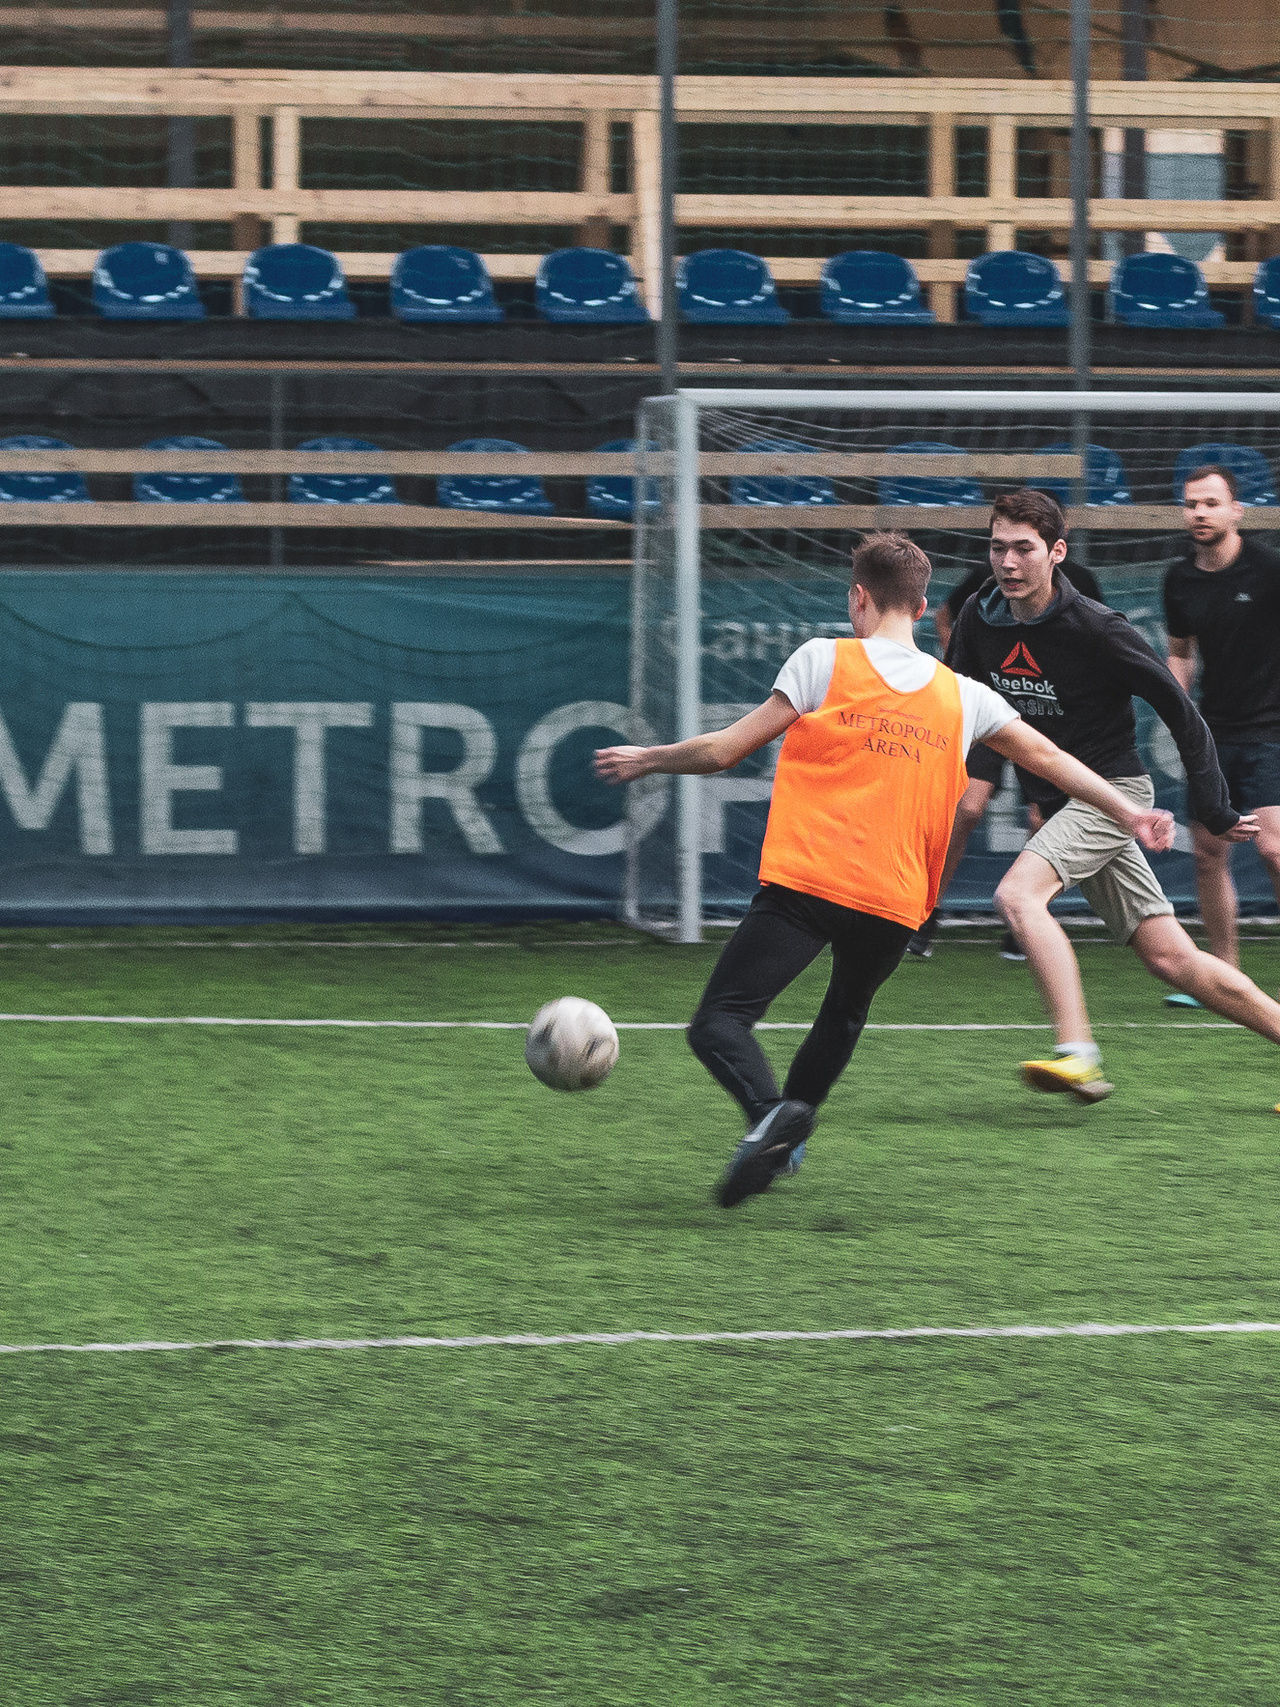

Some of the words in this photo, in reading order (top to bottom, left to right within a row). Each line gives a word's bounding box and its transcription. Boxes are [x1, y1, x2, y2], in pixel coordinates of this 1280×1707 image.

[990, 671, 1056, 695] Reebok
[837, 711, 949, 752] METROPOLIS
[861, 736, 921, 764] ARENA
